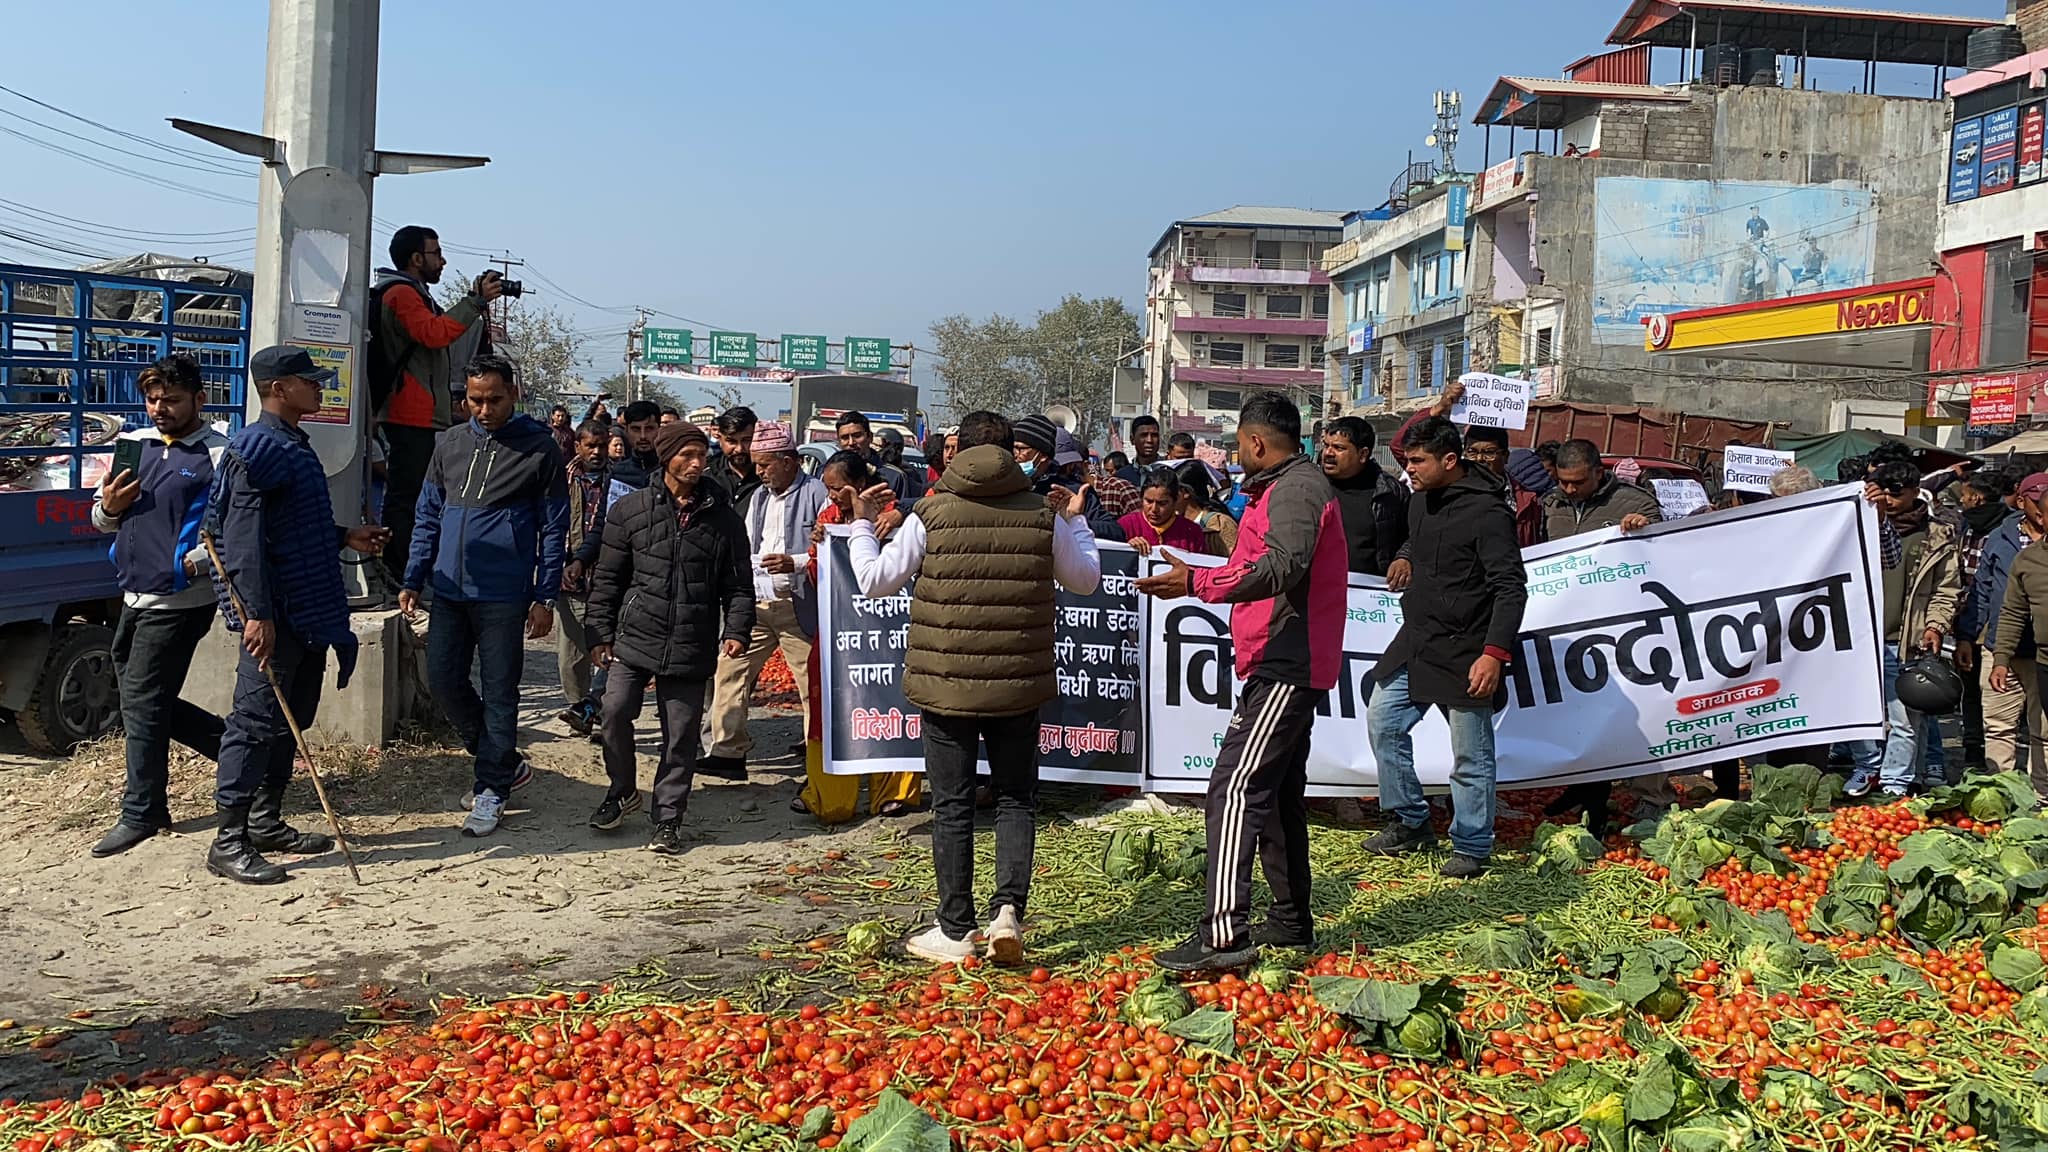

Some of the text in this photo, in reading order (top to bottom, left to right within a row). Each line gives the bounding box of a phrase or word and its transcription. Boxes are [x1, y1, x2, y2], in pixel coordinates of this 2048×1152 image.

[304, 309, 342, 320] Crompton
[1837, 289, 1935, 330] Nepal Oil
[717, 350, 750, 358] BHALUBANG
[791, 353, 817, 361] ATTARIYA
[854, 356, 882, 364] SURKHET
[1726, 449, 1753, 465] किसान
[1726, 468, 1772, 485] जिन्दावा
[867, 630, 882, 651] त
[1080, 643, 1116, 665] ऋण
[847, 662, 896, 688] लागत
[1691, 683, 1766, 712] आयोजक
[851, 707, 904, 741] विदेशी
[1665, 710, 1736, 736] किसान
[1735, 715, 1809, 740] चितवन
[1183, 755, 1214, 771] २०७
